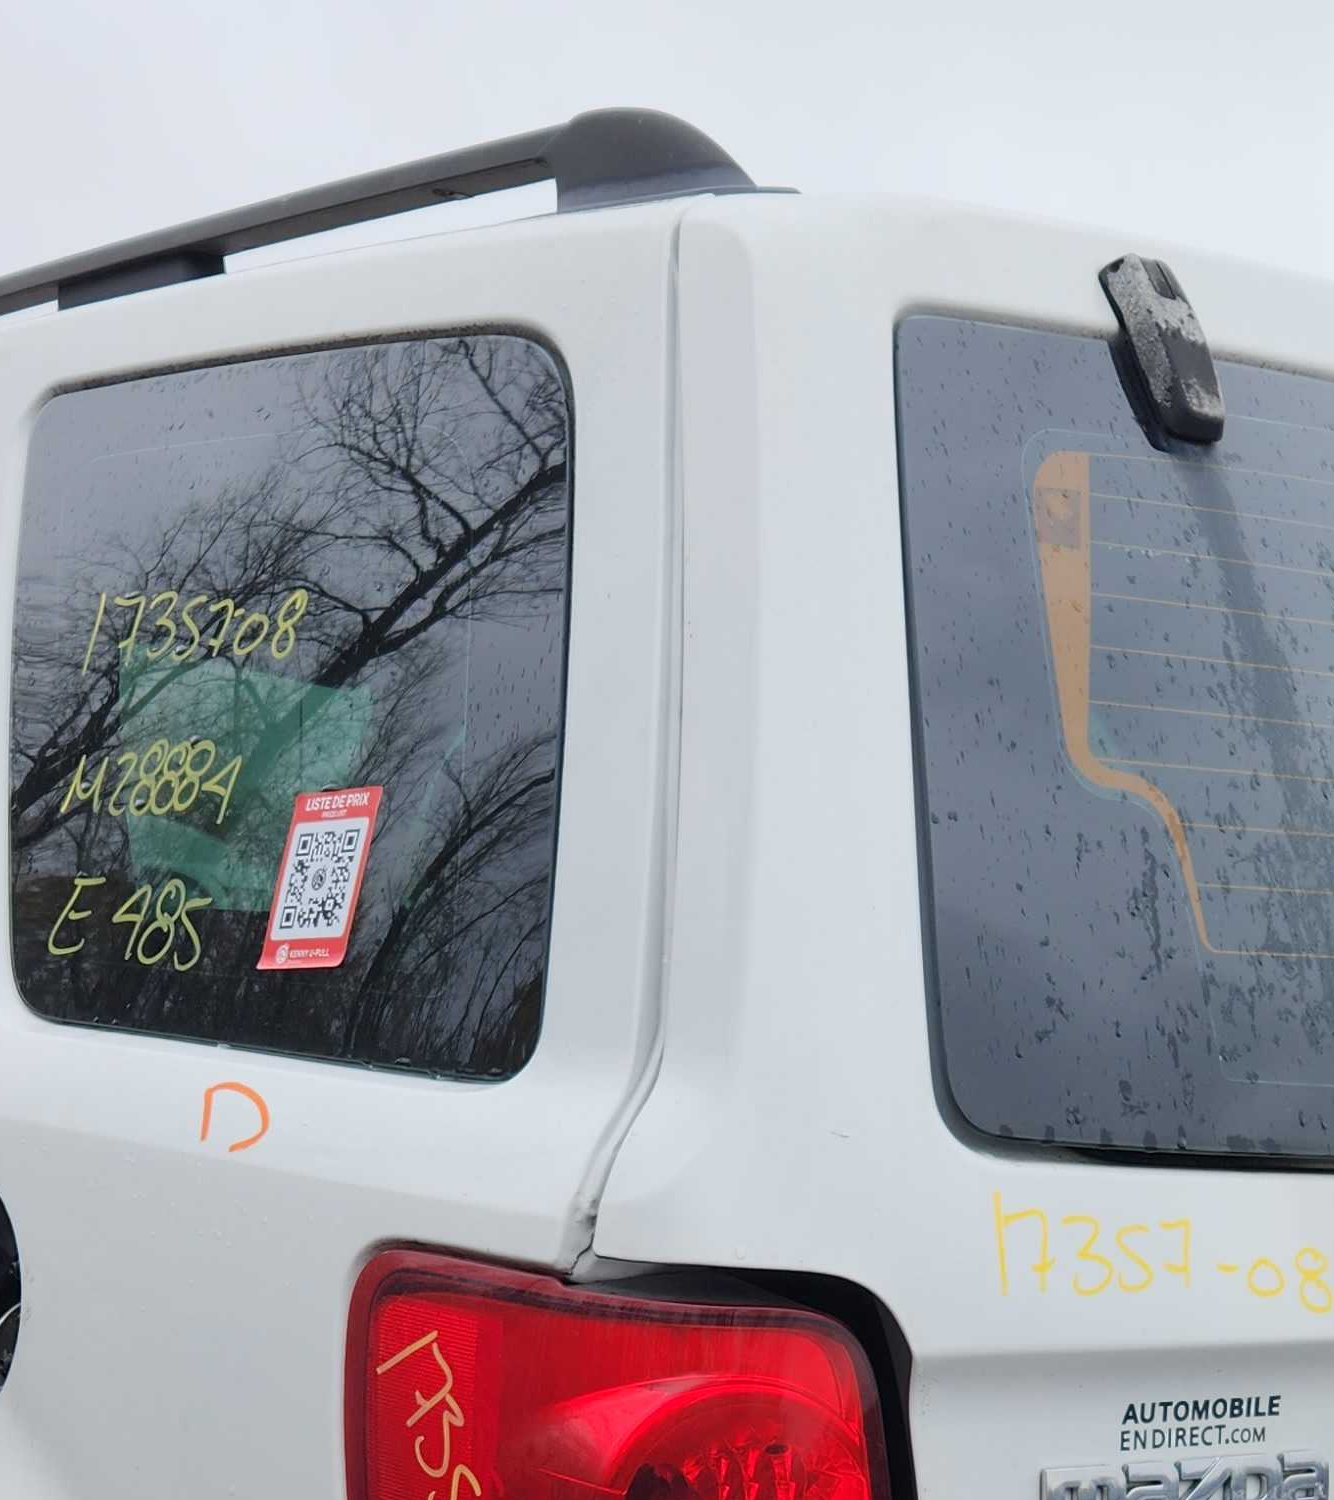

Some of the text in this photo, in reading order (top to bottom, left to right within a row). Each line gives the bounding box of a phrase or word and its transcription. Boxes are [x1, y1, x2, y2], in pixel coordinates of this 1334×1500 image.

[305, 791, 371, 812] LISTE DE PRIX
[48, 876, 213, 972] E 485
[201, 1081, 269, 1153] D
[993, 1190, 1334, 1313] 17357-08
[1121, 1395, 1282, 1426] AUTOMOBILE
